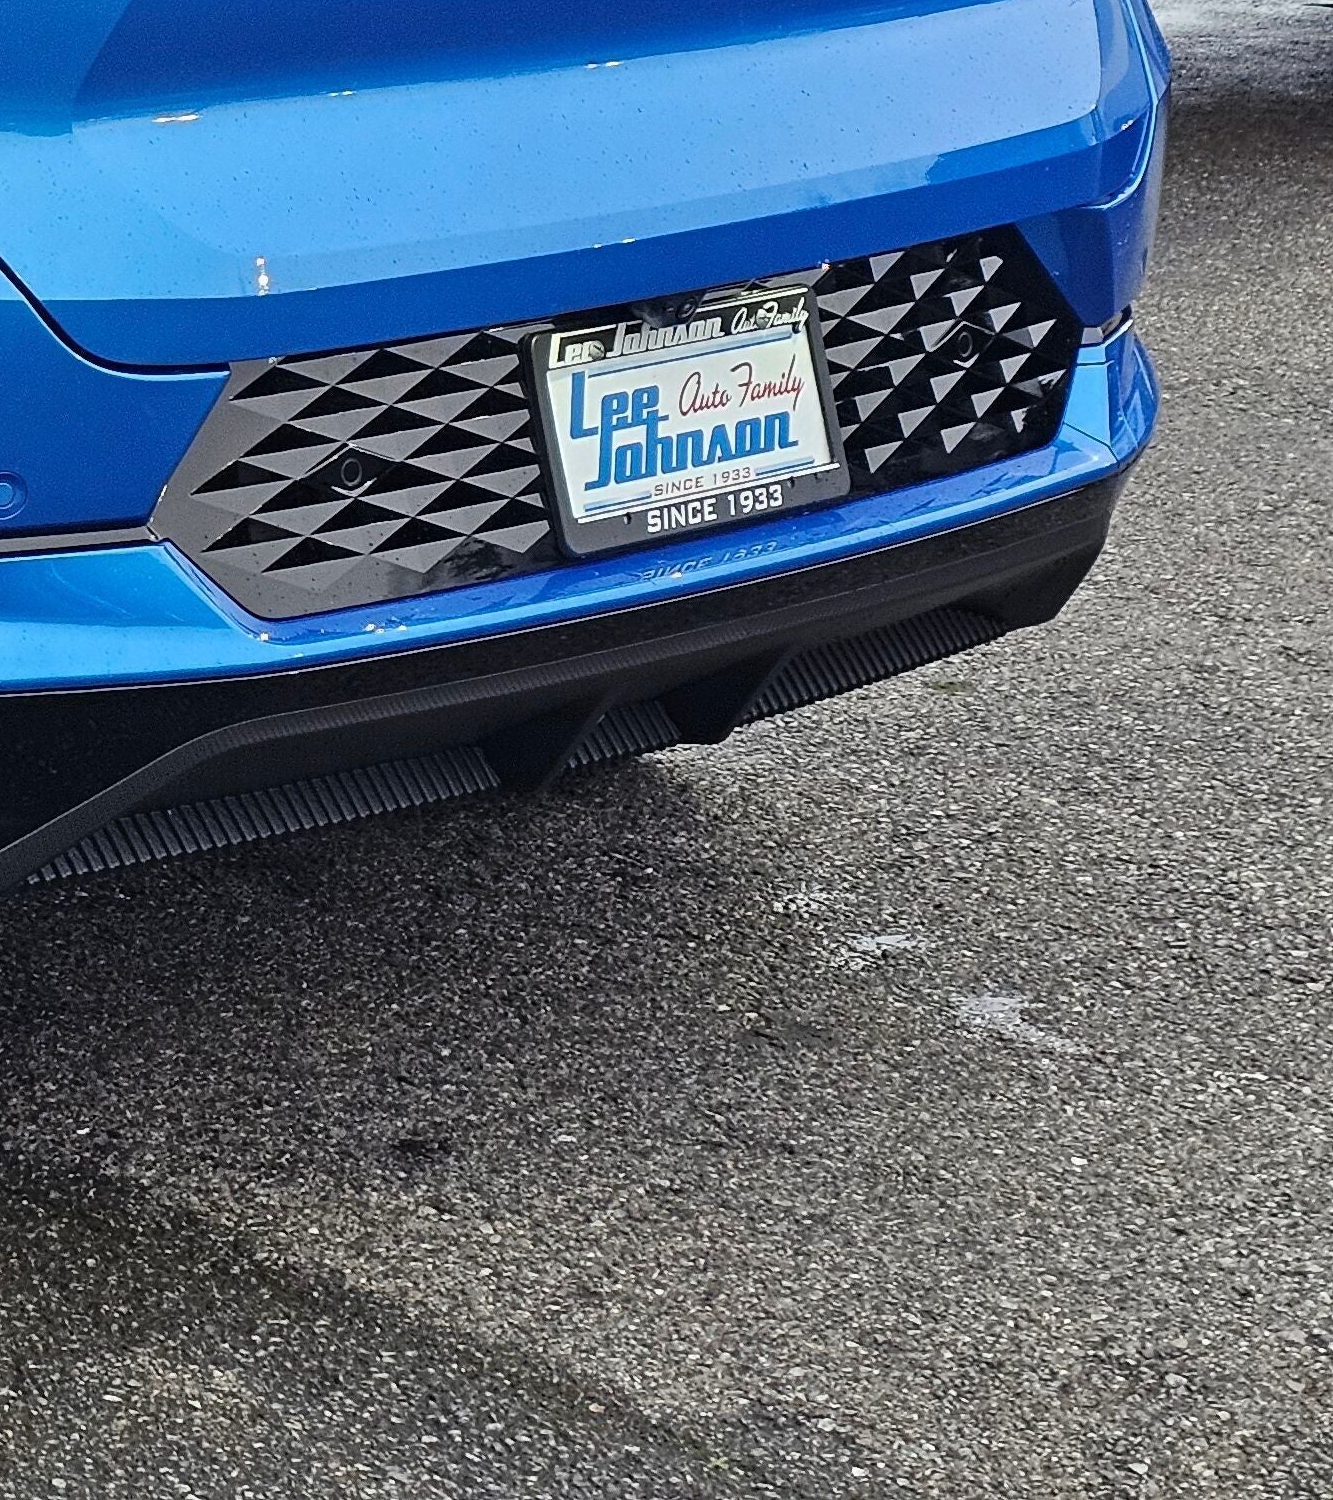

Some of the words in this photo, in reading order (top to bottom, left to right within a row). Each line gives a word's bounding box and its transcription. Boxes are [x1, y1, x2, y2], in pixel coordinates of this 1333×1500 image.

[606, 317, 726, 357] Johnson
[570, 370, 669, 439] Lee
[679, 371, 731, 417] Auto
[730, 353, 804, 411] Family
[584, 409, 798, 491] Johnson
[654, 481, 704, 497] SINCE
[712, 467, 752, 486] 1933
[646, 497, 718, 533] SINCE
[727, 484, 783, 516] 1933
